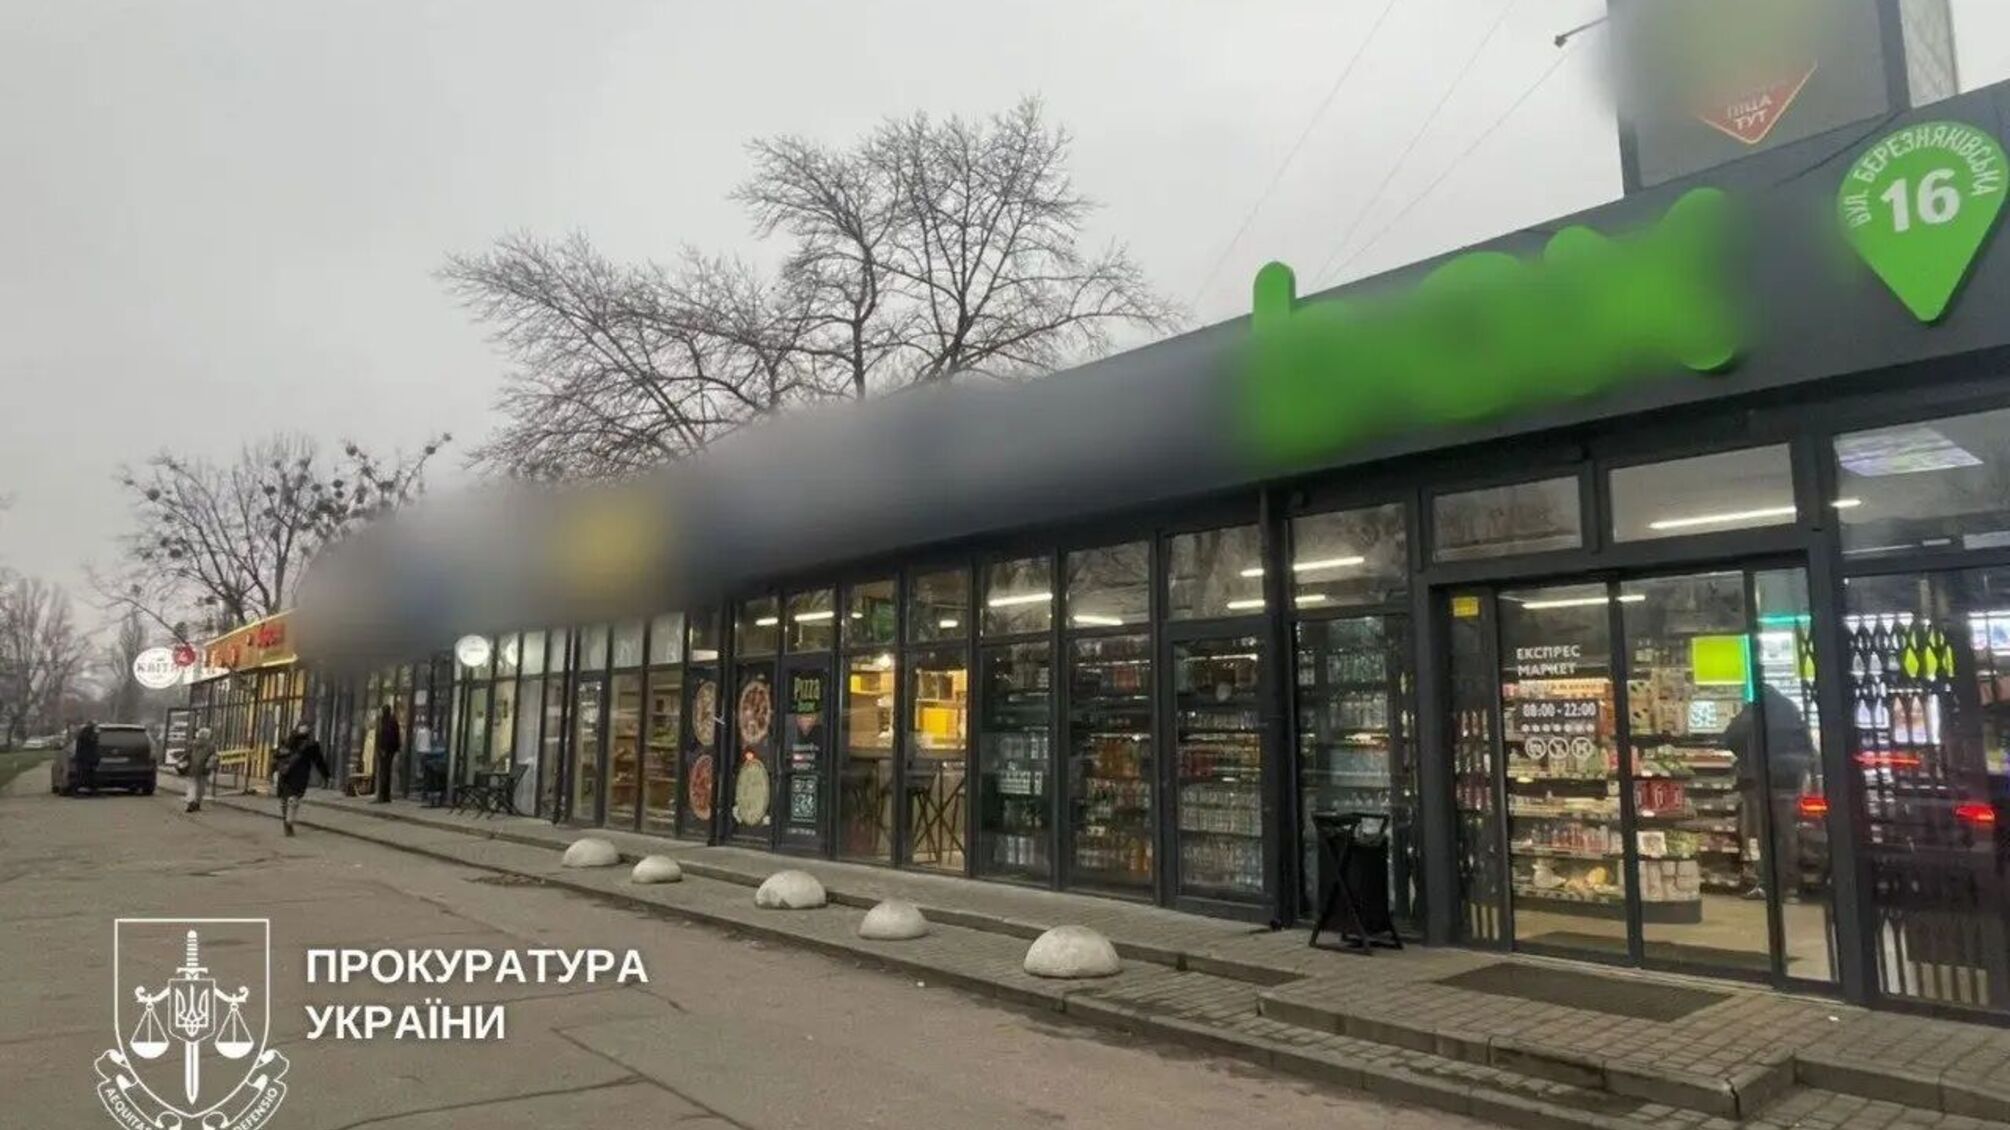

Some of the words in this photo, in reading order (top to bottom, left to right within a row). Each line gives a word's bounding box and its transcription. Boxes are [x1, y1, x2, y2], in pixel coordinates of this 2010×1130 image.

[1735, 108, 1768, 130] ТУТ
[1853, 125, 2001, 196] БЕРЕЗНЯКІВСЬКА
[1880, 167, 1961, 232] 16
[1516, 644, 1581, 660] ЕКСПРЕС
[1517, 662, 1577, 676] МАРКЕТ
[1563, 702, 1597, 717] 22:00
